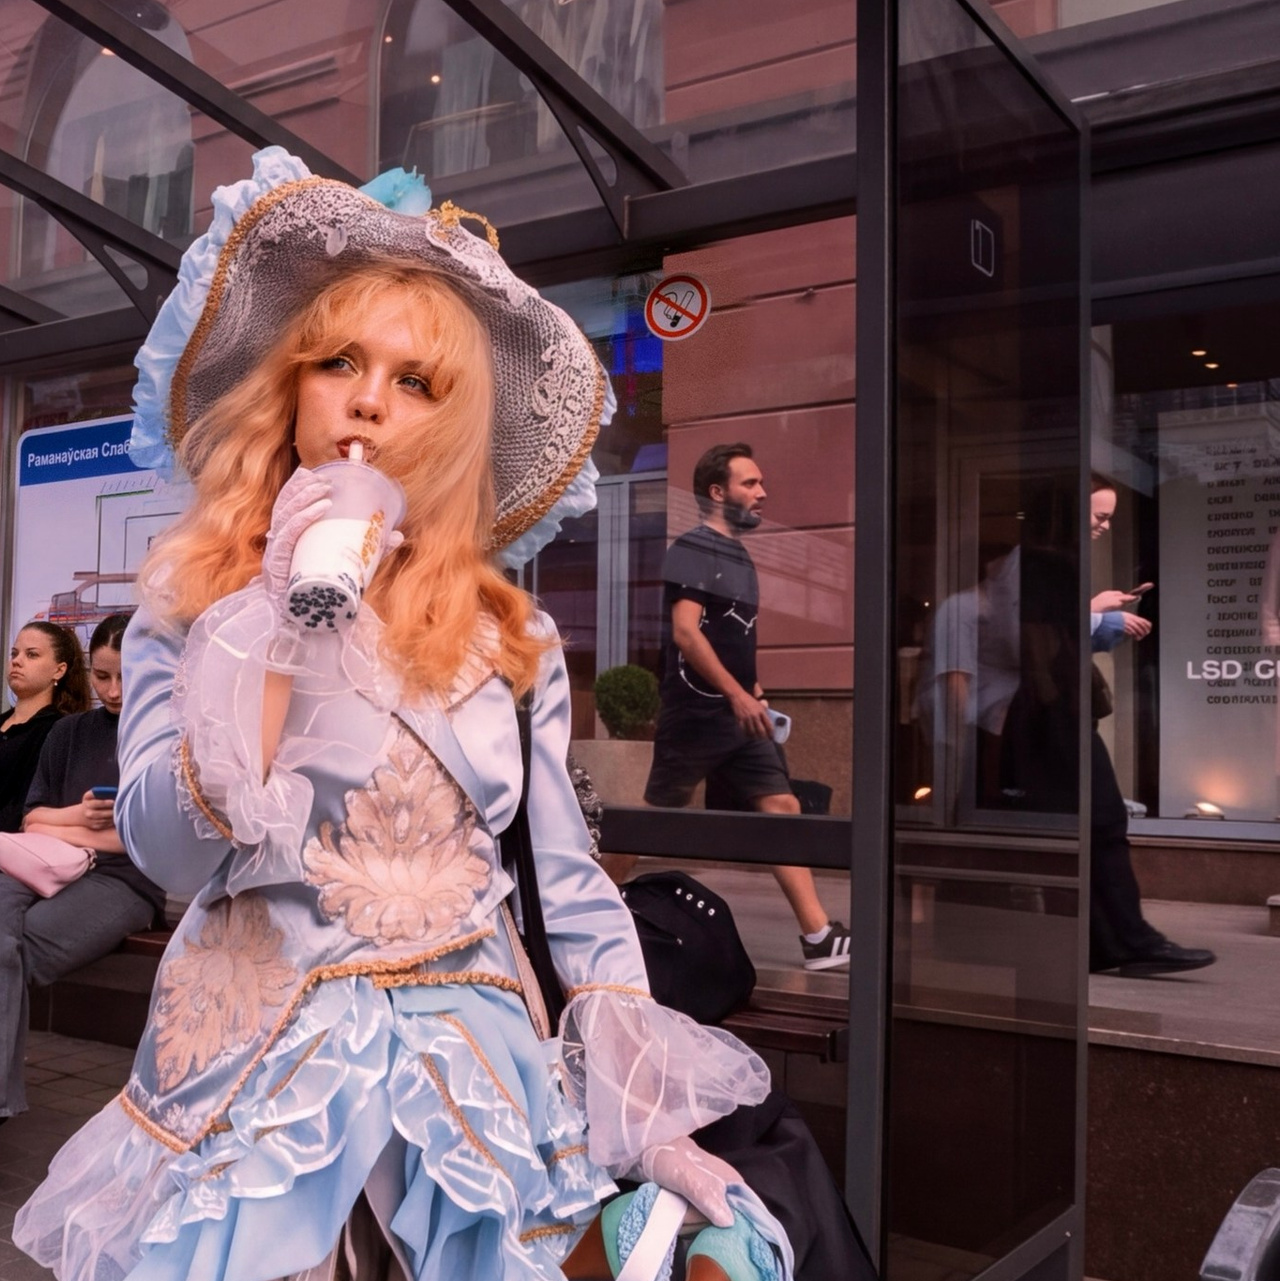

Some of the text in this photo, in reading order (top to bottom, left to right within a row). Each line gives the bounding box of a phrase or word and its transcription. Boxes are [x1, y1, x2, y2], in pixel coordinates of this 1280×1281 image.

[27, 439, 132, 468] Раманаўская Слаб
[1186, 659, 1280, 680] LSD G
